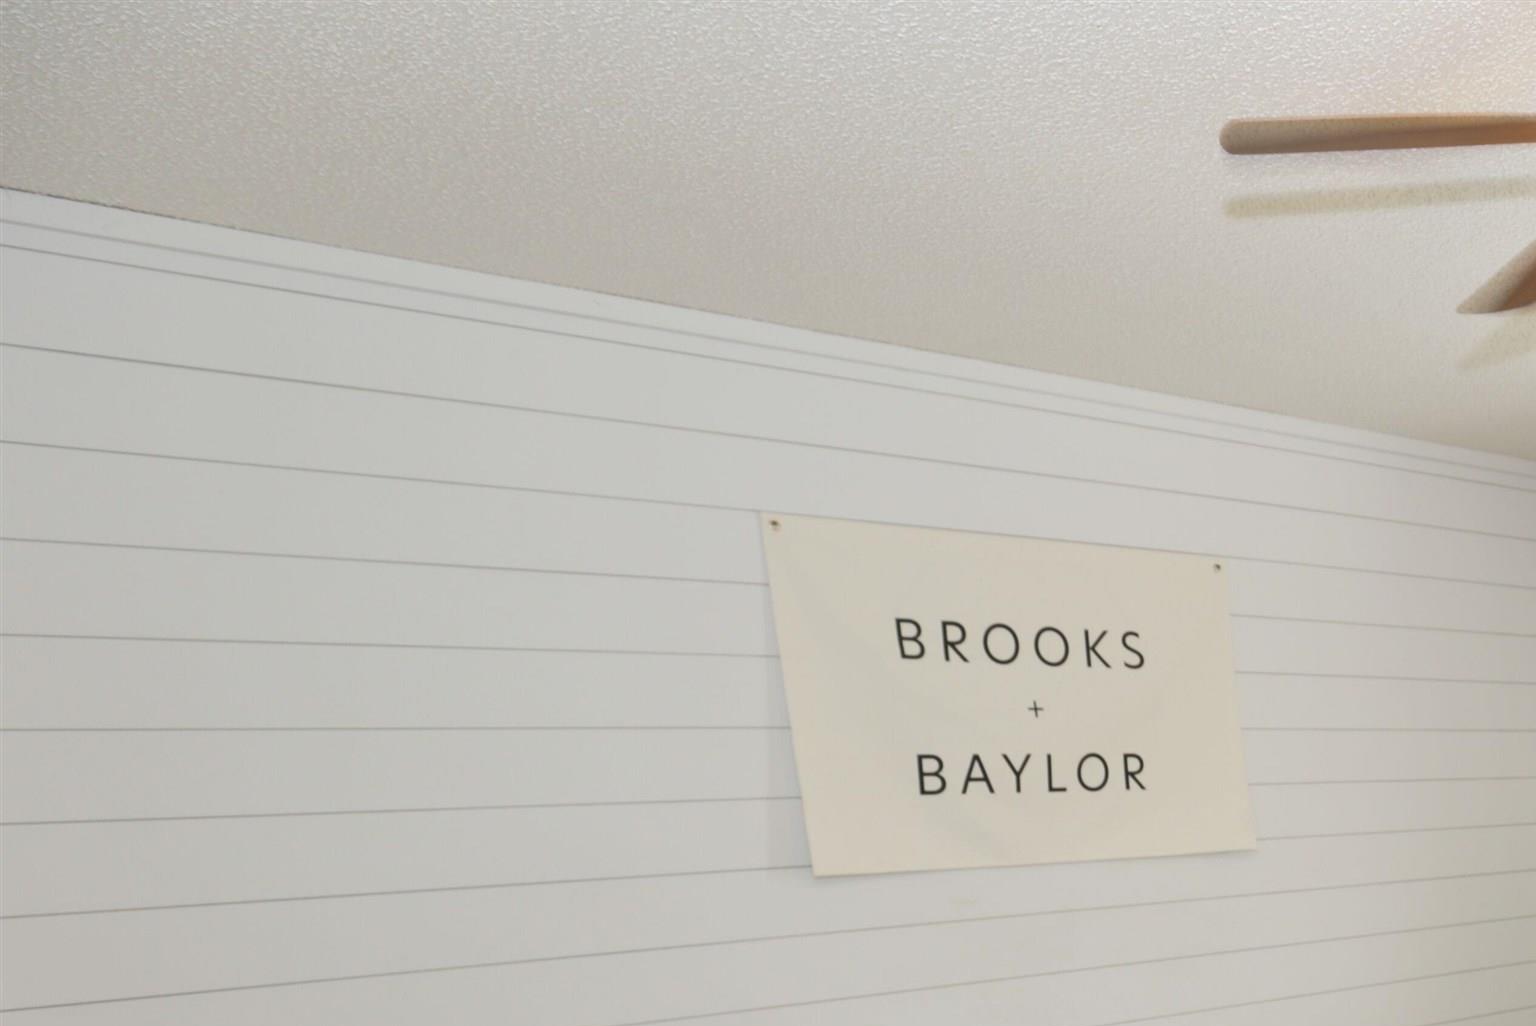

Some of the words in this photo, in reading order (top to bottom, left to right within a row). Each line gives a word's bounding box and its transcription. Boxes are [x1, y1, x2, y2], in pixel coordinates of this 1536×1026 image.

[894, 617, 1146, 670] BROOKS
[1027, 700, 1044, 719] +
[916, 752, 1147, 796] BAYLOR
